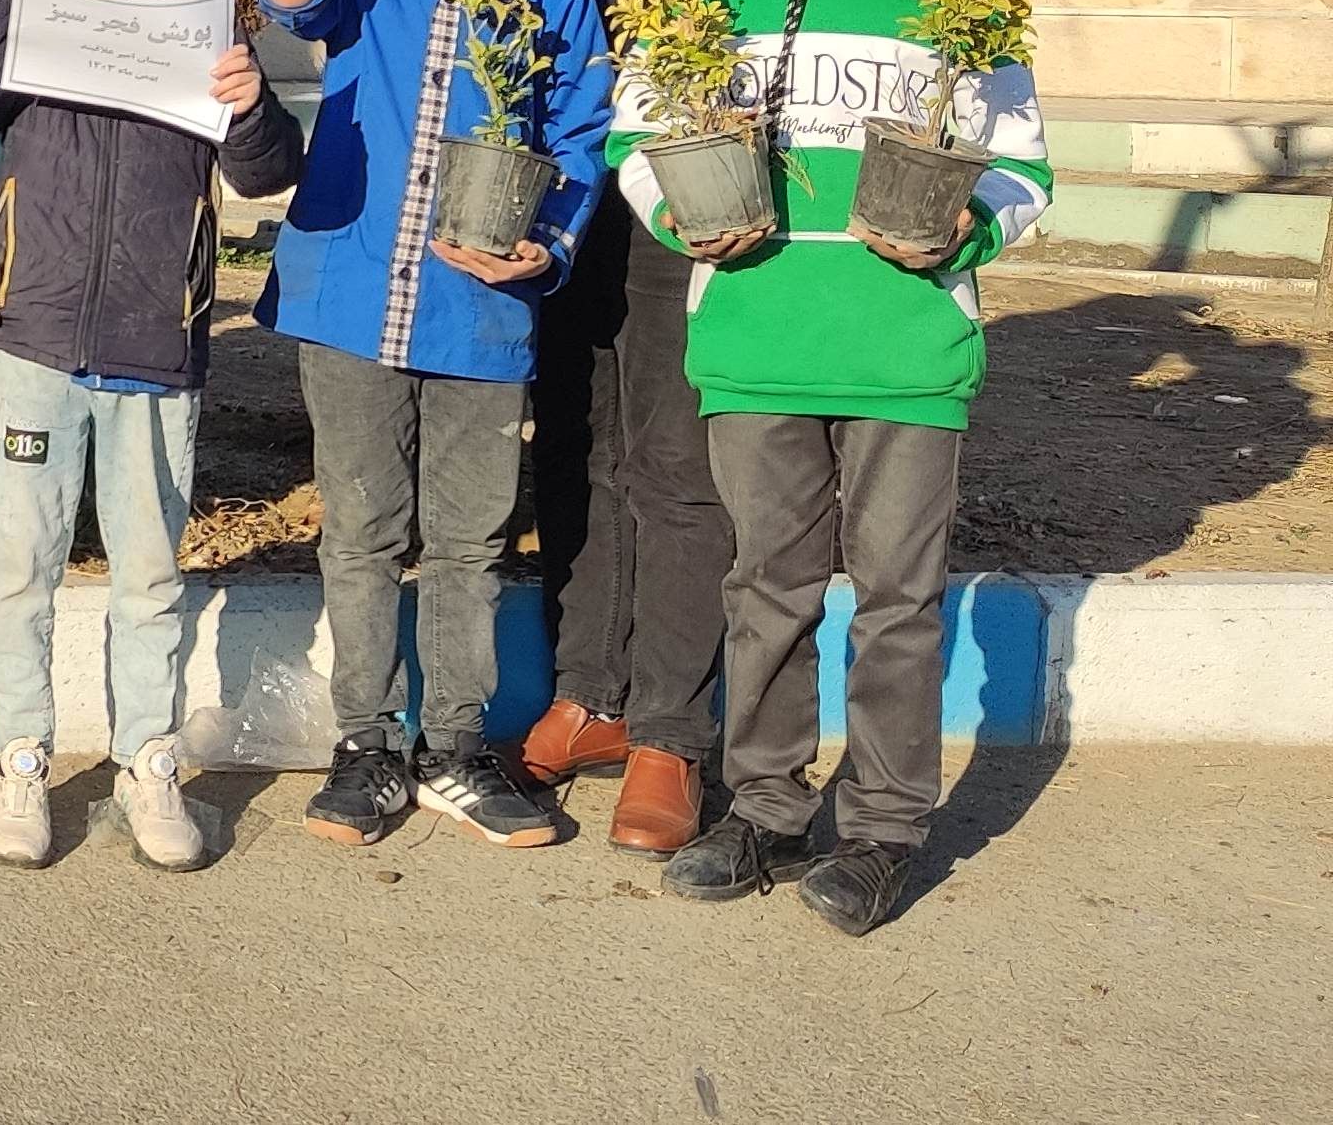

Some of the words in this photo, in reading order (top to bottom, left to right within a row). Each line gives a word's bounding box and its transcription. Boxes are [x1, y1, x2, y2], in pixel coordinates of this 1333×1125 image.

[44, 3, 87, 24] سبز
[93, 16, 141, 36] فجر
[147, 21, 213, 49] پویش
